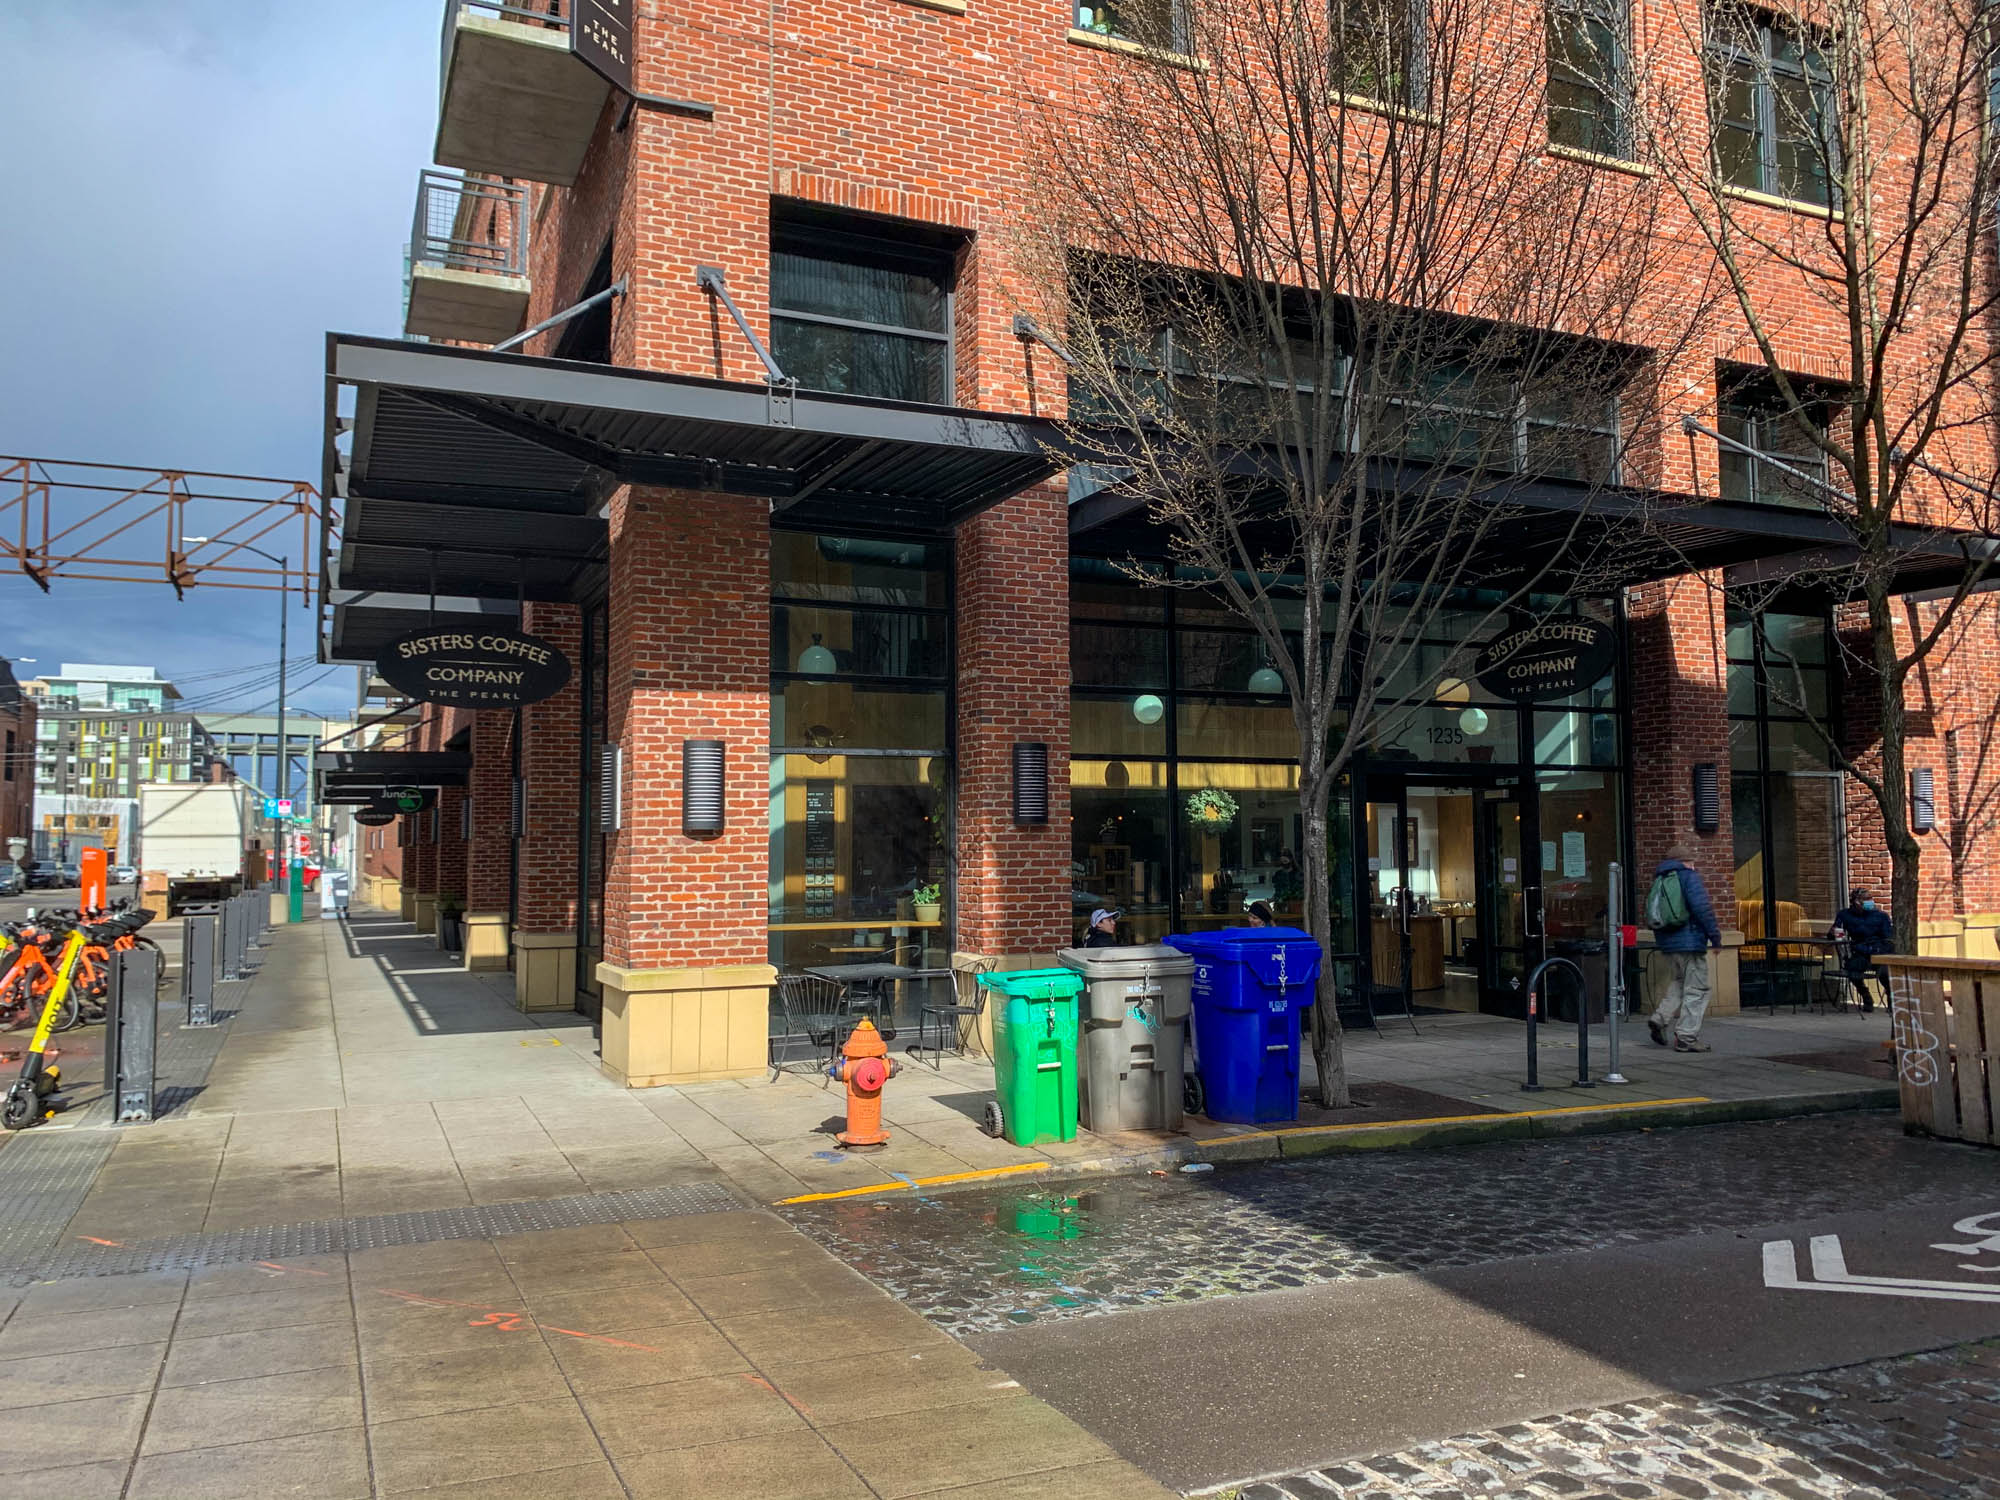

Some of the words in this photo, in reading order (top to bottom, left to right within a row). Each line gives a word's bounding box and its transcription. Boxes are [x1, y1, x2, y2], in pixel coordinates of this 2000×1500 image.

[593, 19, 618, 46] THE
[584, 25, 625, 64] PEARL
[399, 634, 474, 658] SISTERS
[477, 635, 552, 666] COFFEE
[1488, 629, 1540, 661] SISTERS
[1541, 625, 1597, 645] COFFEE
[426, 667, 524, 685] COMPANY
[1507, 656, 1577, 679] COMPANY
[428, 689, 460, 698] THE
[469, 691, 521, 700] PEARL
[1510, 686, 1532, 694] THE
[1538, 679, 1576, 690] PEARL
[1426, 727, 1463, 745] 1235
[381, 789, 407, 799] Juno
